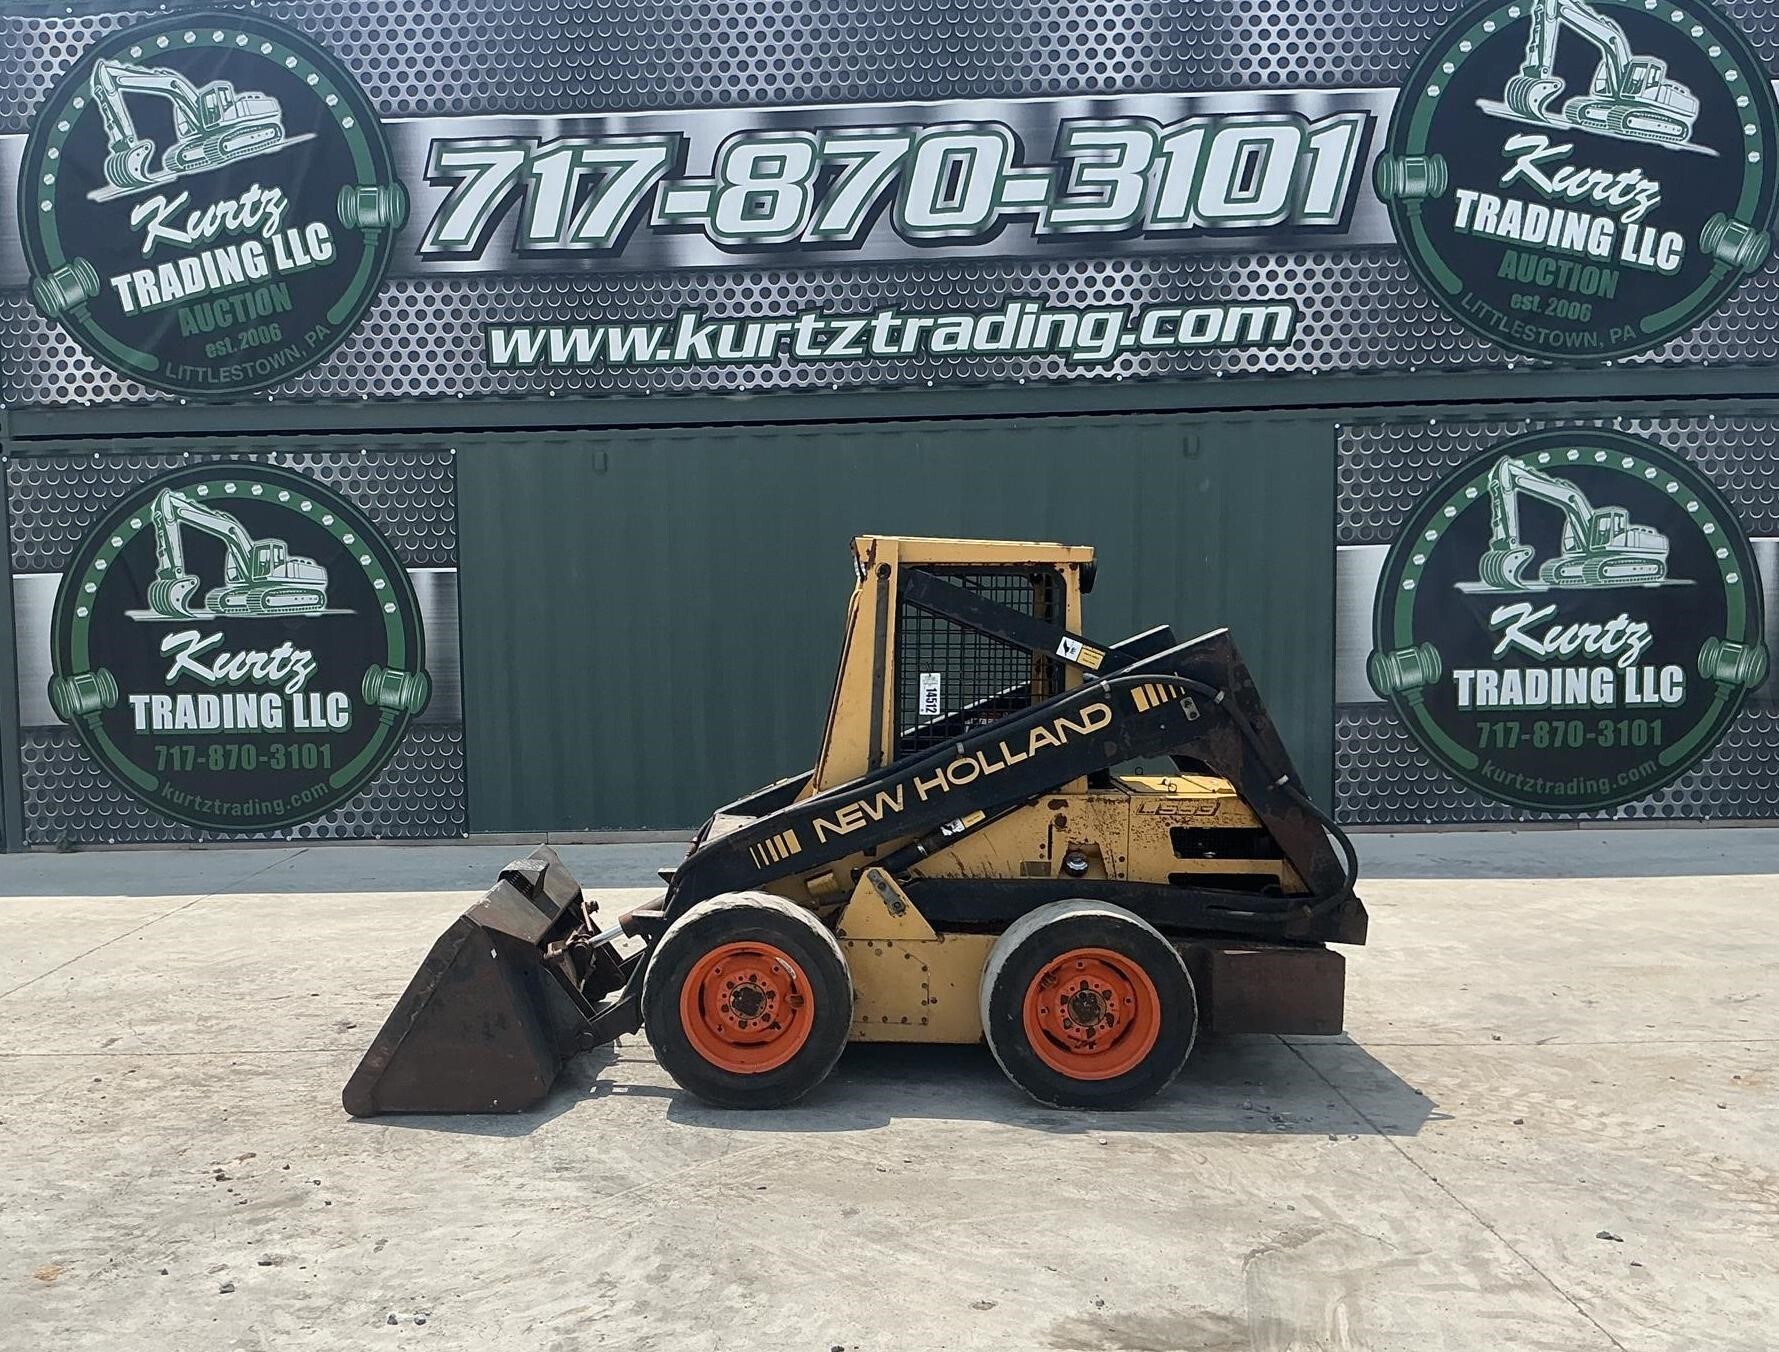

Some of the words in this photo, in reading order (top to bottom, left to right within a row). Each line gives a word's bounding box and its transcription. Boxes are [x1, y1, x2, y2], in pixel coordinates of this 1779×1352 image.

[430, 117, 1360, 248] 717-870-3101
[1501, 133, 1661, 224] Kurtz
[130, 183, 288, 254] Kurtz
[1454, 188, 1615, 258] TRADING
[1620, 223, 1684, 271] LLC
[110, 240, 269, 312] TRADING
[271, 222, 333, 271] LLC
[1497, 249, 1620, 299] AUCTION
[176, 281, 293, 337] AUCTION
[489, 300, 1294, 365] www.kurtztrading.com
[1461, 291, 1604, 348] LITTLESTOWN,
[1610, 324, 1637, 344] PA
[1544, 296, 1593, 322] 2006
[165, 344, 307, 383] LITTLESTOWN,
[304, 324, 331, 348] PA
[160, 629, 318, 694] Kurtz
[1490, 602, 1653, 668] Kurtz
[128, 692, 283, 730] TRADING
[292, 691, 349, 728] LLC
[925, 687, 938, 714] 14512
[1452, 666, 1614, 706] TRADING
[1624, 665, 1684, 703] LLC
[154, 742, 332, 772] 717-870-3101
[1476, 718, 1663, 749] 717-870-3101
[161, 780, 330, 817] kurtztrading.com
[812, 784, 904, 844] NEW
[913, 702, 1112, 801] HOLLAND
[1481, 759, 1658, 796] kurtztrading.com
